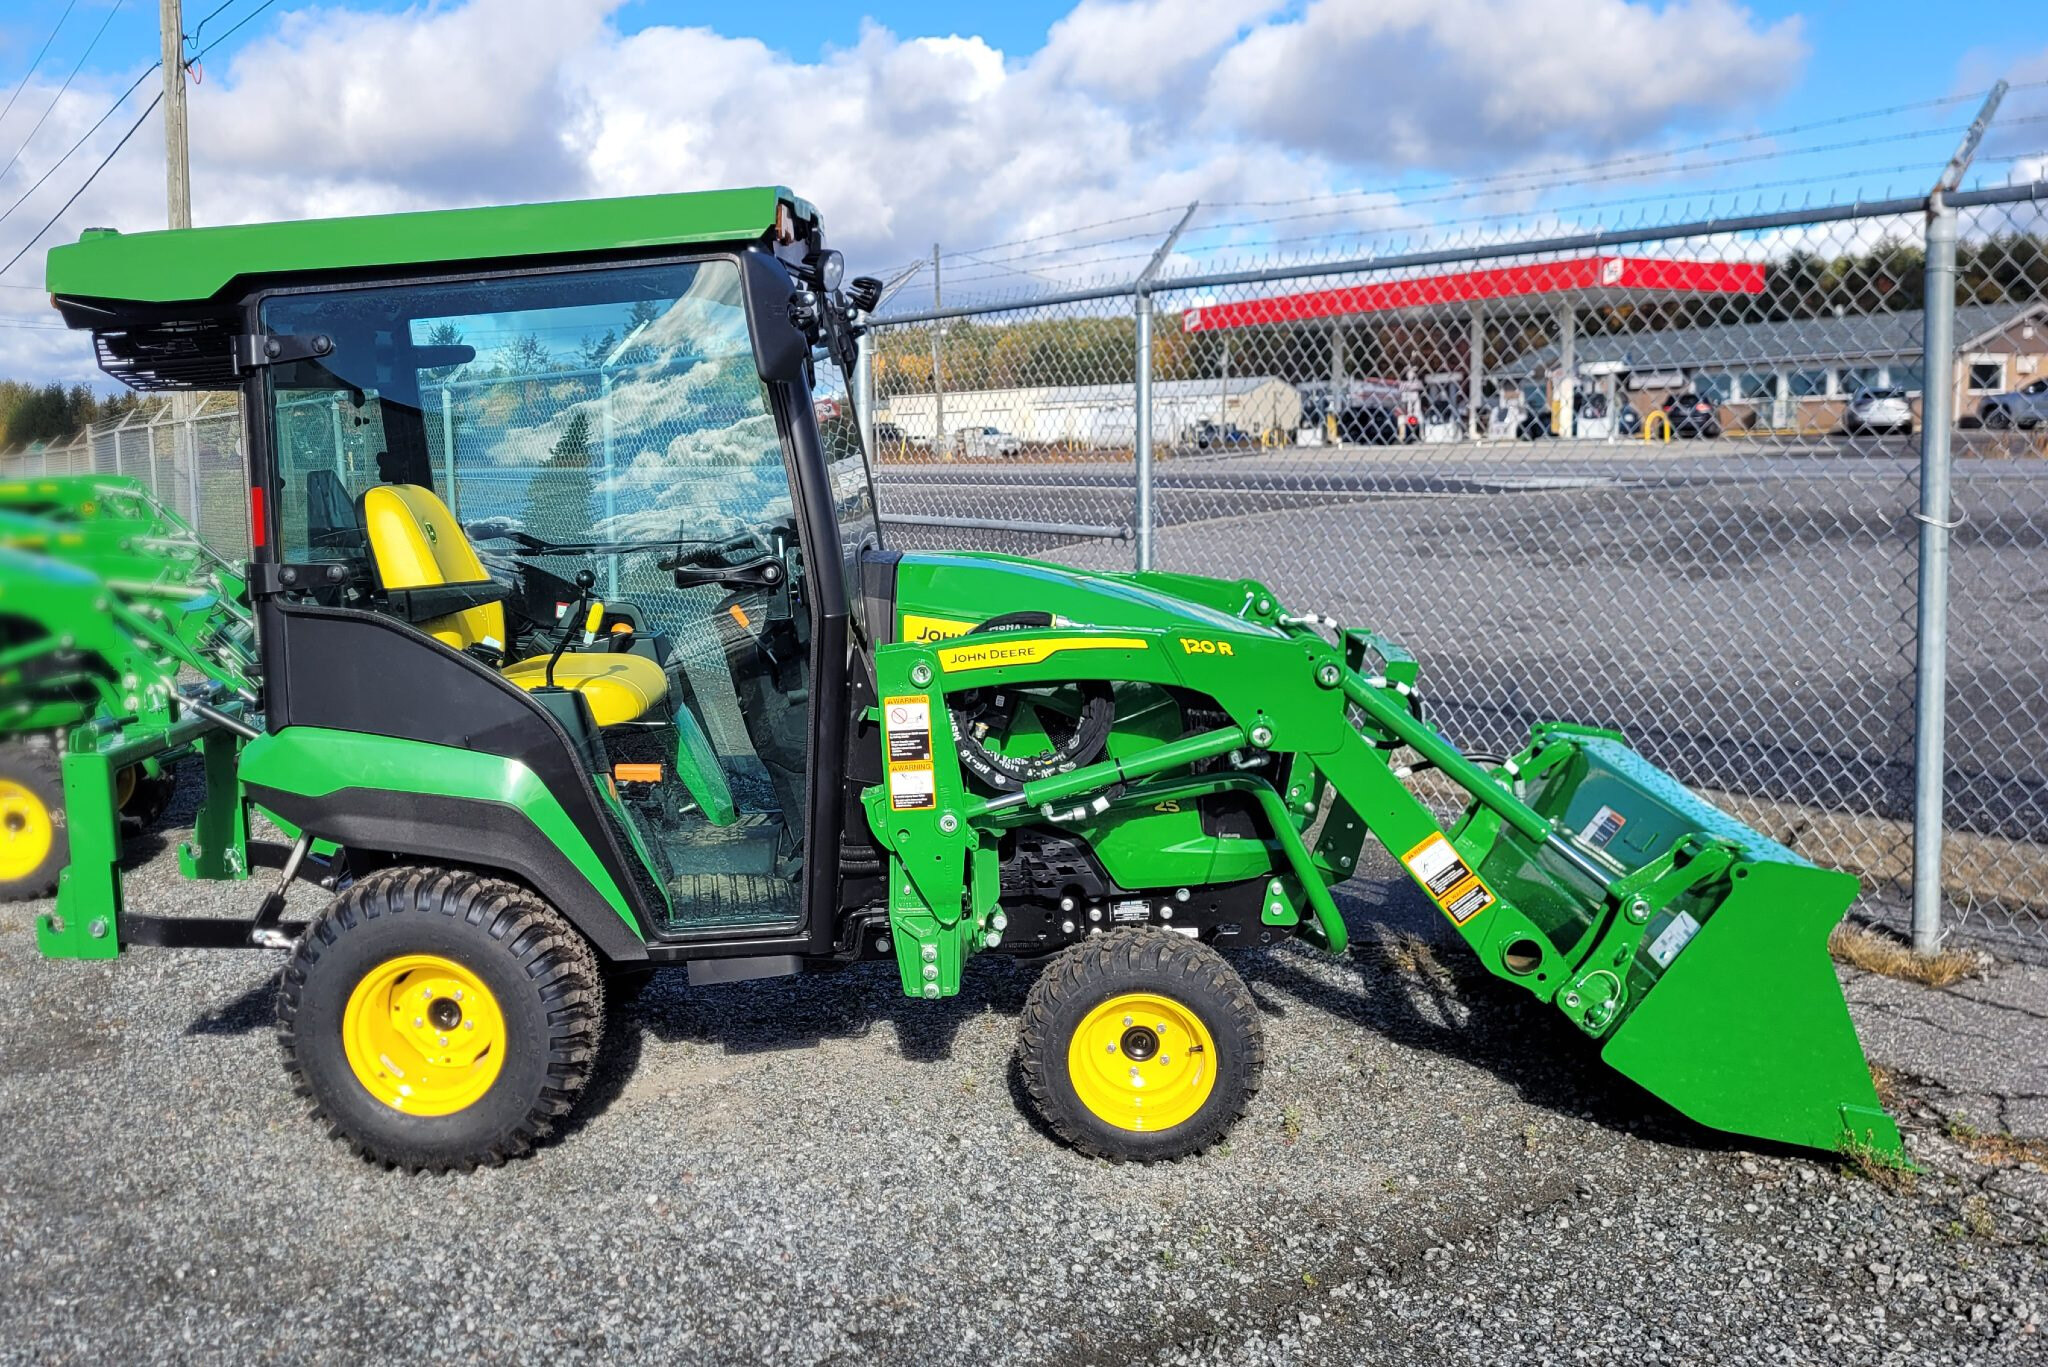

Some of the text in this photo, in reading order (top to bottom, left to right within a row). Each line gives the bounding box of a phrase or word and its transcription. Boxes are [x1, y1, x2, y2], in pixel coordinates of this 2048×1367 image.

[916, 626, 968, 642] JOH
[950, 647, 1036, 664] JOHN DEERE
[894, 696, 927, 705] WARNING
[897, 763, 931, 771] WARNING
